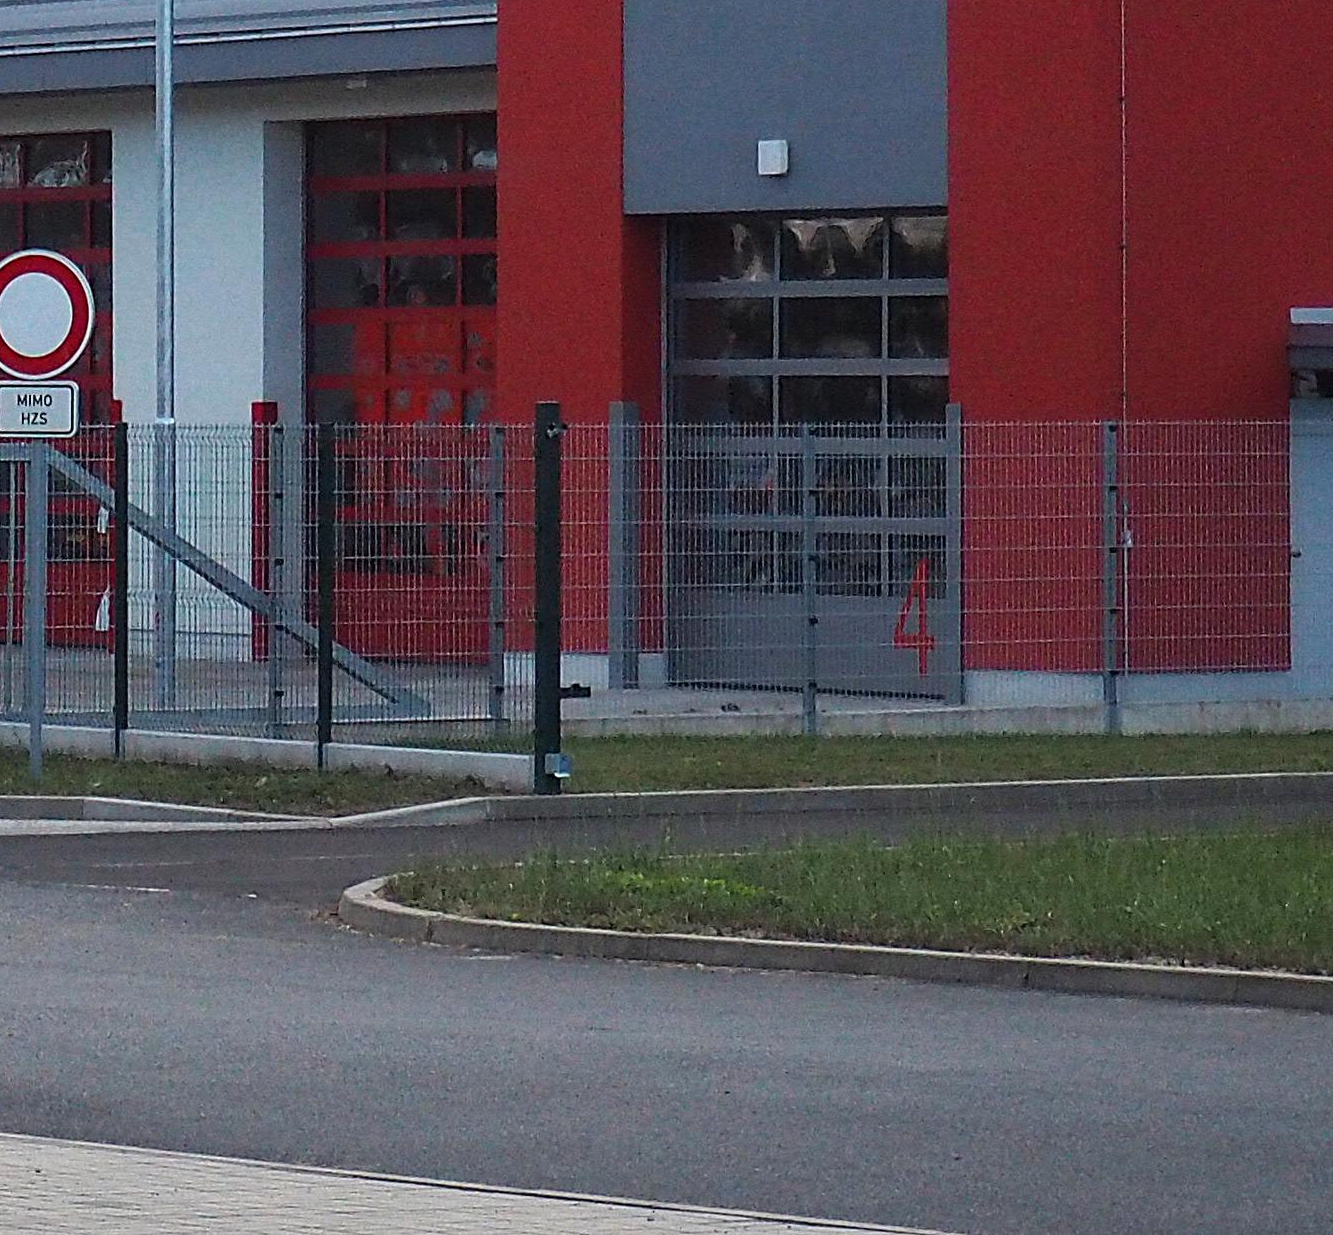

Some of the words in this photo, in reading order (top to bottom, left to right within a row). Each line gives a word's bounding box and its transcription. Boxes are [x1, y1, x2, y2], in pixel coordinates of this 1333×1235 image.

[16, 394, 53, 407] MIMO
[21, 412, 48, 425] HZS
[893, 556, 935, 679] 4
